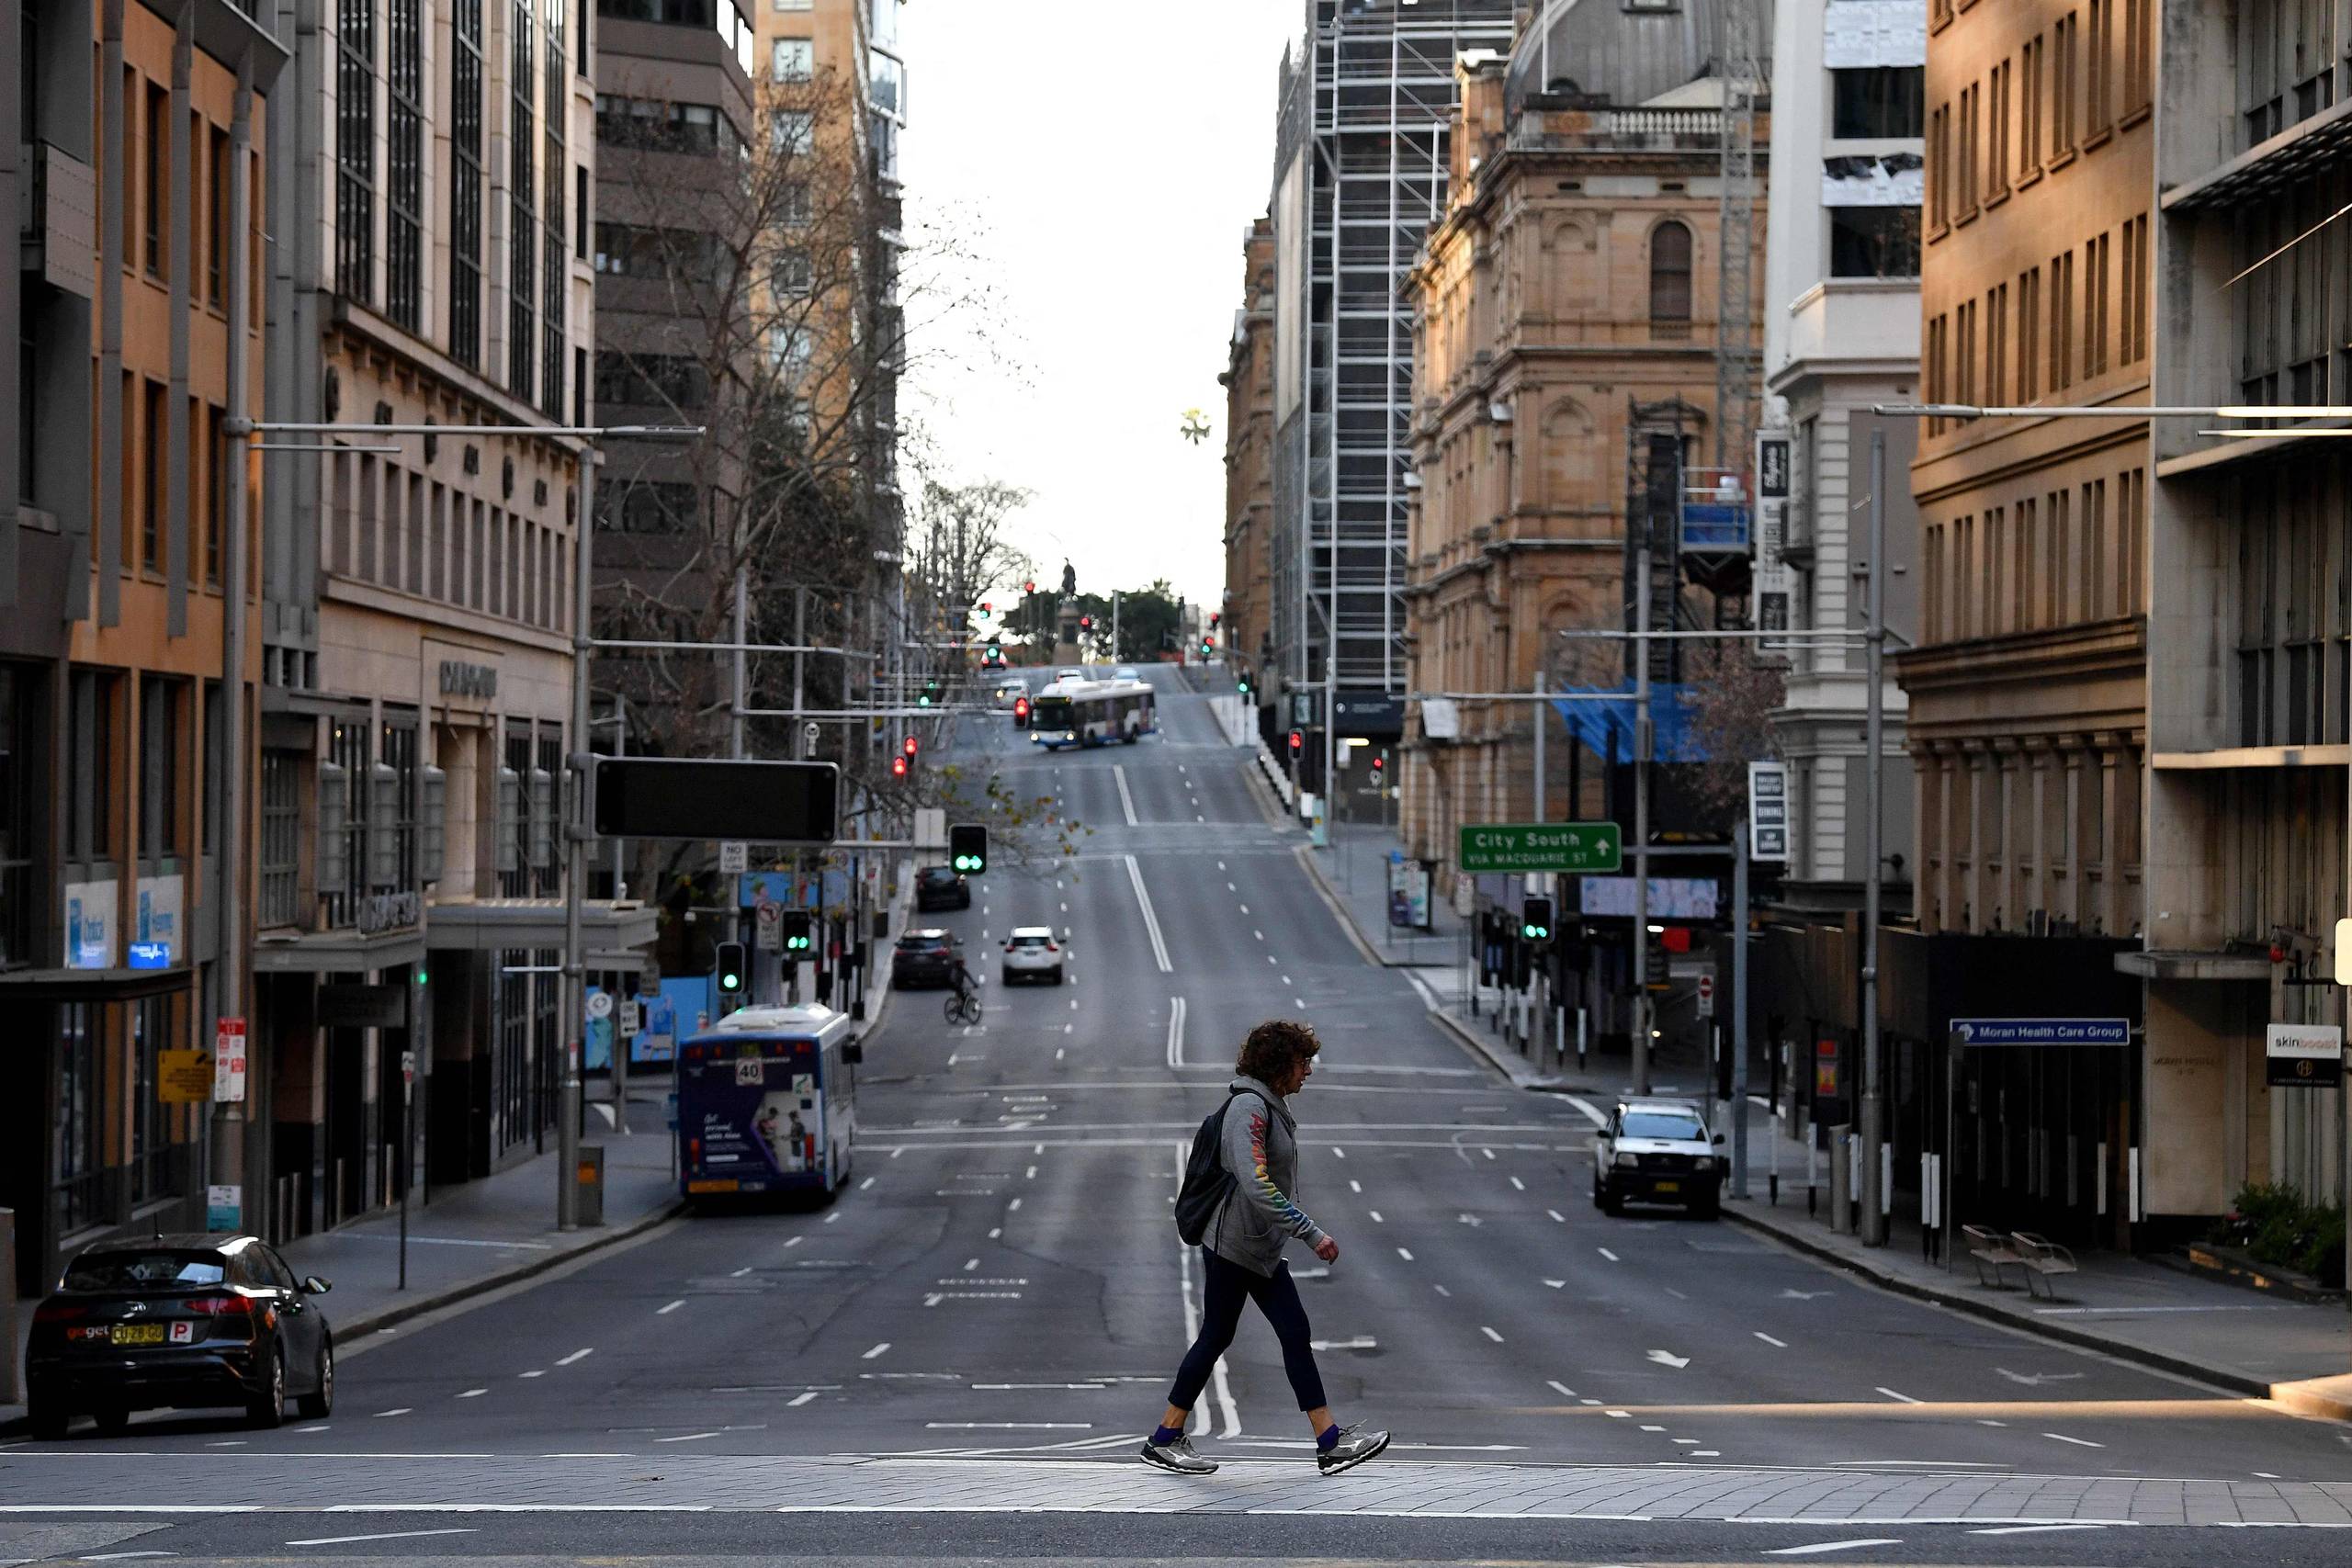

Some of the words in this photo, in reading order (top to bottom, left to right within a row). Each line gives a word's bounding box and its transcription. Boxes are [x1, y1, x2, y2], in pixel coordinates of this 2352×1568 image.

[1475, 832, 1515, 850] City
[1526, 831, 1580, 847] South
[1466, 853, 1490, 864] VIA
[1494, 852, 1566, 864] MACQUARIE
[1573, 852, 1588, 864] ST
[1979, 1026, 2016, 1037] Moran
[2018, 1026, 2054, 1037] Health
[2057, 1026, 2085, 1037] Care
[2087, 1025, 2123, 1039] Group
[2275, 1036, 2337, 1049] skinboost
[740, 1065, 759, 1077] 40
[67, 1324, 109, 1340] goget
[175, 1324, 188, 1339] P
